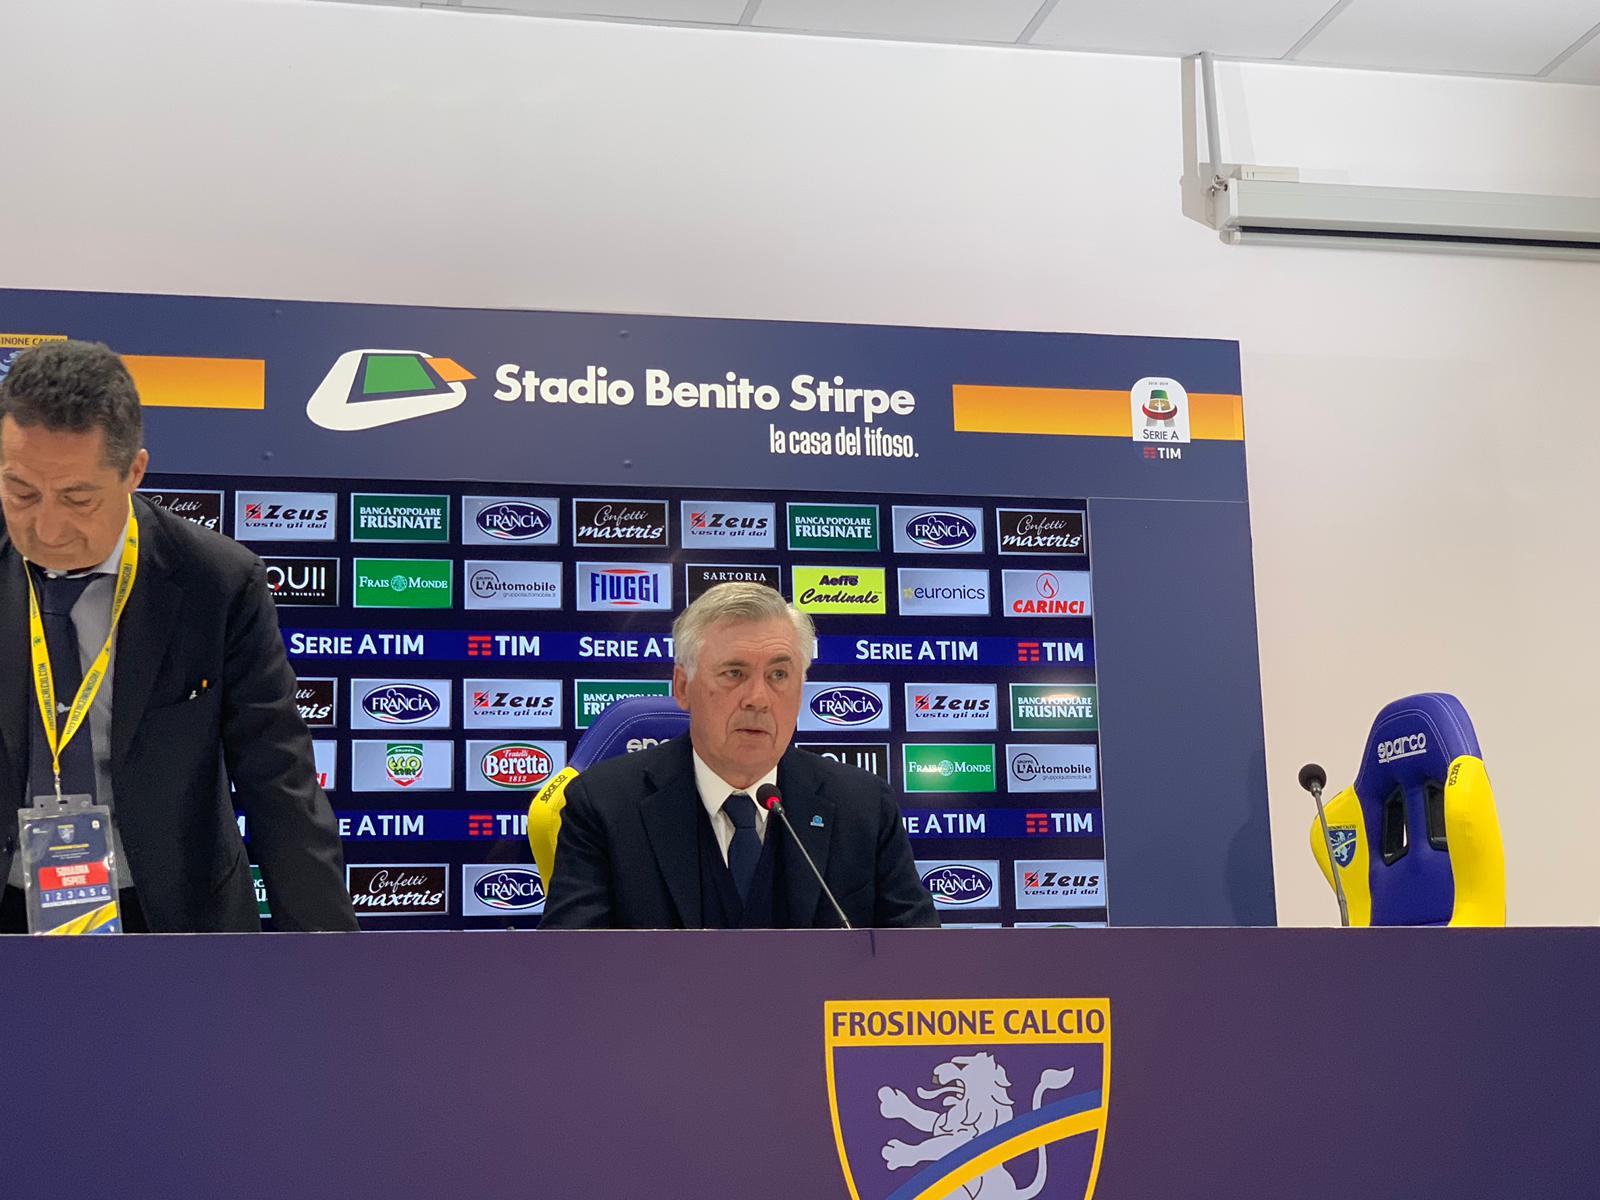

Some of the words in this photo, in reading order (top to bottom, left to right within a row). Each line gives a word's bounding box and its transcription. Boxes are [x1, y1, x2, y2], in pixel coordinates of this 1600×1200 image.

[0, 336, 30, 346] INONE
[493, 363, 634, 405] Stadio
[645, 368, 781, 411] Benito
[789, 374, 916, 423] Stirpe
[769, 424, 786, 454] la
[789, 432, 831, 455] casa
[835, 427, 861, 456] del
[864, 427, 920, 459] tifoso.
[1142, 429, 1168, 440] SERIE
[1170, 430, 1179, 440] A
[1157, 447, 1181, 460] TIM
[266, 505, 328, 520] Zeus
[360, 506, 391, 515] BANCA
[393, 507, 441, 516] POPOLARE
[594, 504, 649, 527] Confetti
[286, 521, 304, 529] gli
[307, 521, 327, 529] dei
[360, 515, 442, 529] FRUSINATE
[485, 510, 544, 530] FRANCIA
[709, 515, 769, 529] Zeus
[795, 516, 823, 525] BANCA
[825, 517, 872, 526] POPOLARE
[1017, 514, 1067, 535] Confetti
[578, 523, 664, 539] maxtris
[730, 529, 747, 537] gli
[795, 525, 872, 538] FRUSINATE
[915, 521, 969, 538] FRANCIA
[1002, 534, 1081, 547] maxtris
[408, 577, 448, 589] MONDE
[703, 572, 767, 581] SARTORIA
[476, 581, 556, 592] L'Automobile
[590, 572, 658, 604] FIUGGI
[914, 586, 985, 600] euronics
[800, 588, 880, 604] Cardinale
[1013, 600, 1085, 614] CARINCI
[290, 633, 352, 654] SERIE
[357, 633, 377, 654] A
[379, 634, 424, 655] TIM
[495, 635, 540, 656] TIM
[578, 636, 639, 657] SERIE
[644, 637, 663, 658] A
[856, 639, 912, 660] SERIE
[917, 640, 935, 660] A
[936, 641, 978, 661] TIM
[1043, 642, 1084, 662] TIM
[372, 694, 433, 712] FRANCIA
[494, 692, 555, 708] Zeus
[583, 693, 615, 702] BANCA
[819, 696, 875, 714] FRANCIA
[934, 698, 990, 711] Zeus
[1018, 697, 1046, 705] BANCA
[1048, 697, 1092, 705] POPOLARE
[514, 709, 530, 717] gli
[1018, 705, 1093, 718] FRUSINATE
[1377, 732, 1427, 762] sparco
[486, 755, 549, 776] Beretta
[954, 762, 991, 773] MONDE
[1017, 764, 1092, 774] L'Automobile
[356, 815, 376, 836] A
[378, 815, 424, 836] TIM
[924, 814, 943, 834] A
[943, 814, 985, 834] TIM
[1051, 813, 1093, 833] TIM
[369, 870, 428, 894] Confetti
[929, 874, 984, 892] FRANCIA
[1042, 873, 1099, 887] Zeus
[484, 880, 544, 897] FRANCIA
[1062, 888, 1078, 896] gli
[352, 891, 443, 907] maxtris
[832, 1010, 995, 1036] FROSINONE
[1003, 1009, 1105, 1035] CALCIO
